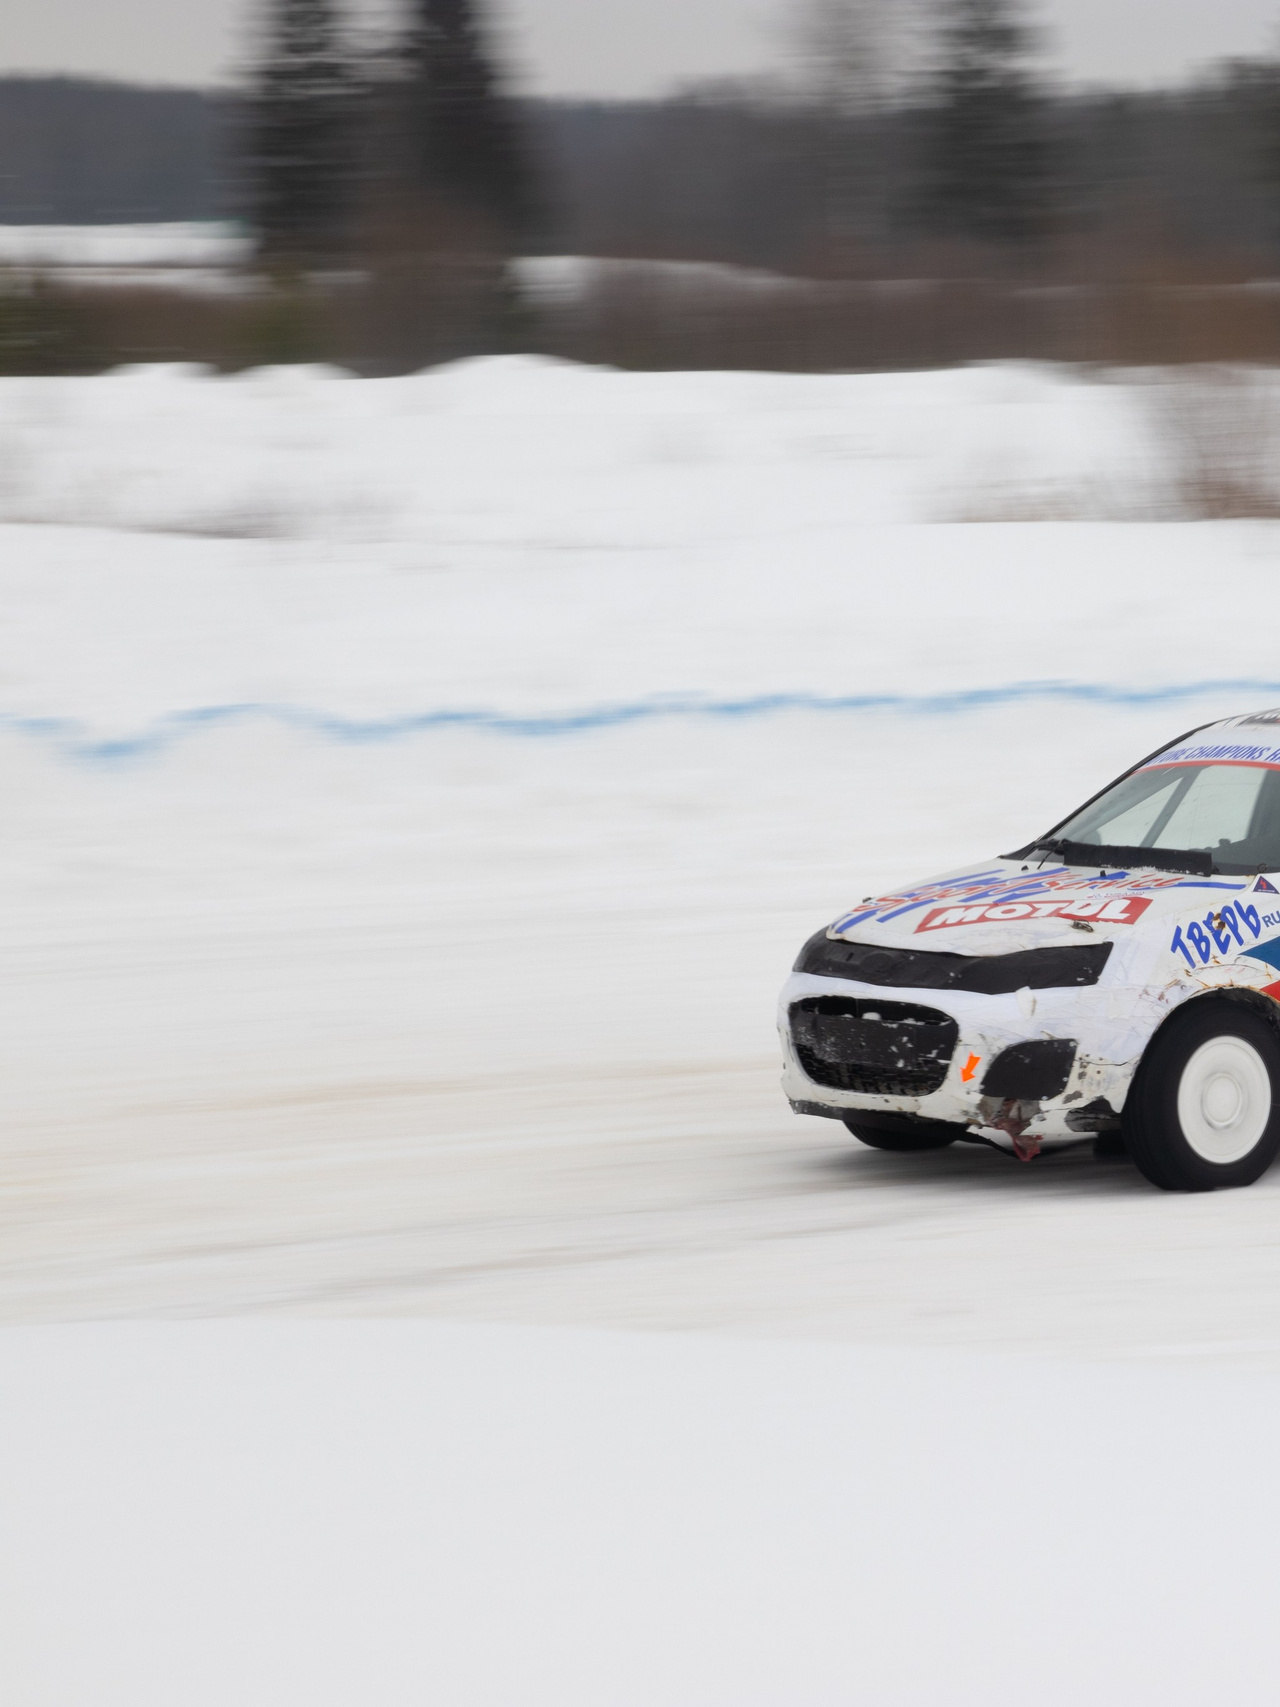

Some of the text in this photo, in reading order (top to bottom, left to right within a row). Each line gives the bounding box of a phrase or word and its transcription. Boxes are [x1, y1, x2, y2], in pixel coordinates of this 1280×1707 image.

[1185, 744, 1271, 762] CHAMPIONS
[926, 899, 1133, 929] MOTUL
[1170, 899, 1262, 969] ТВЕРЬ
